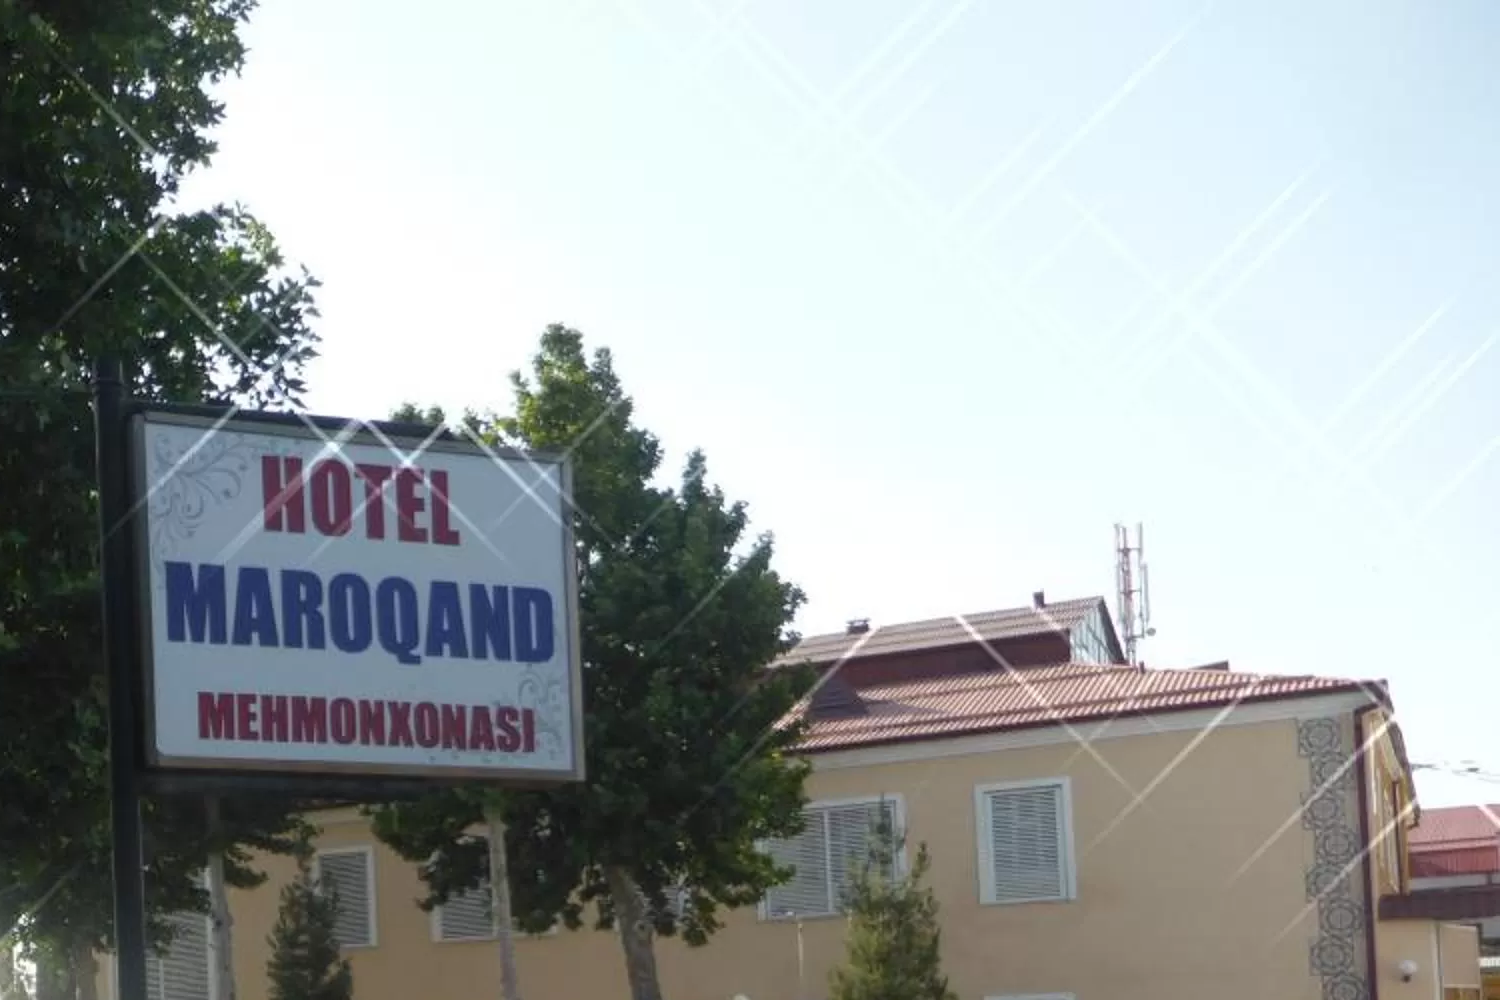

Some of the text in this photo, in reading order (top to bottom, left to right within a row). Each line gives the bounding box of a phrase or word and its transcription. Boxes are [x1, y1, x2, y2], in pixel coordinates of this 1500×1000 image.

[261, 455, 460, 546] HOTEL
[164, 561, 555, 665] MAROQAND
[197, 692, 537, 754] MEHMONXONASI
